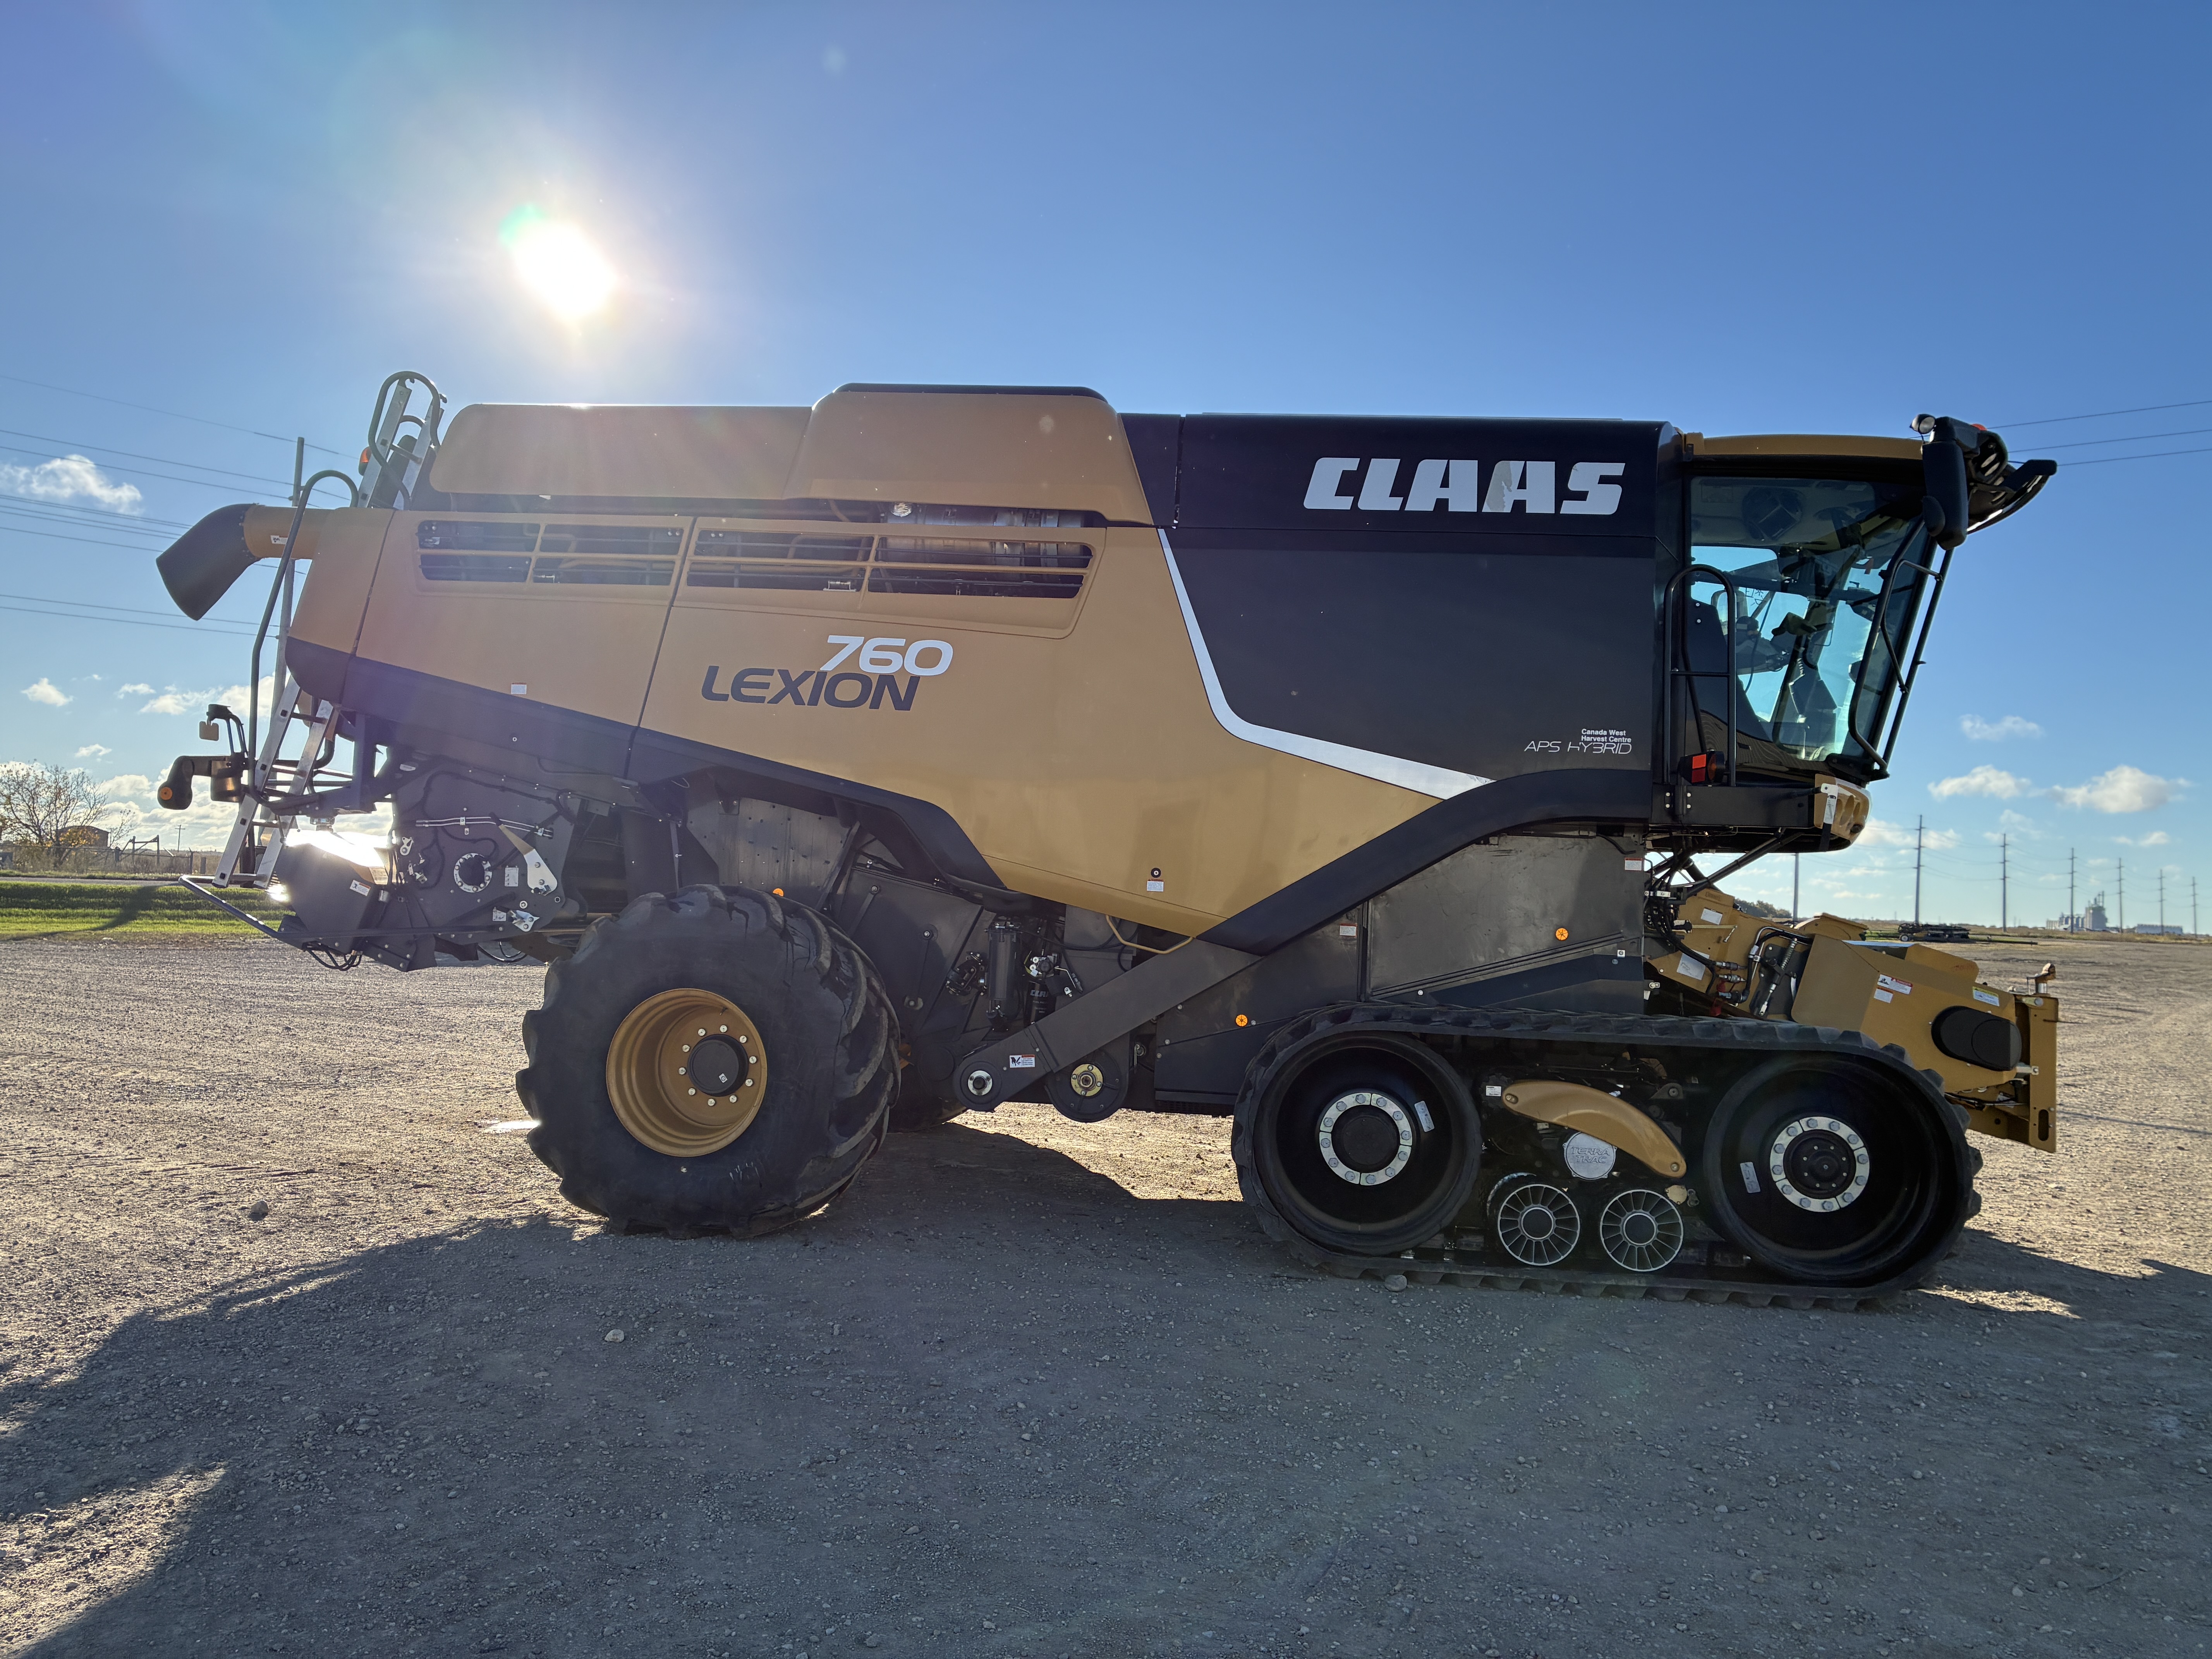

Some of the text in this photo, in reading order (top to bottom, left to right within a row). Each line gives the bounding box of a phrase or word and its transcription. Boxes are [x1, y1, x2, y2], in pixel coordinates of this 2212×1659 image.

[1303, 457, 1626, 515] CLAAS
[819, 635, 953, 676] 760
[701, 665, 921, 711] LEXION
[1524, 740, 1632, 754] APS HYBRID
[1571, 1146, 1610, 1156] TERRA
[1576, 1155, 1607, 1164] TRAC
